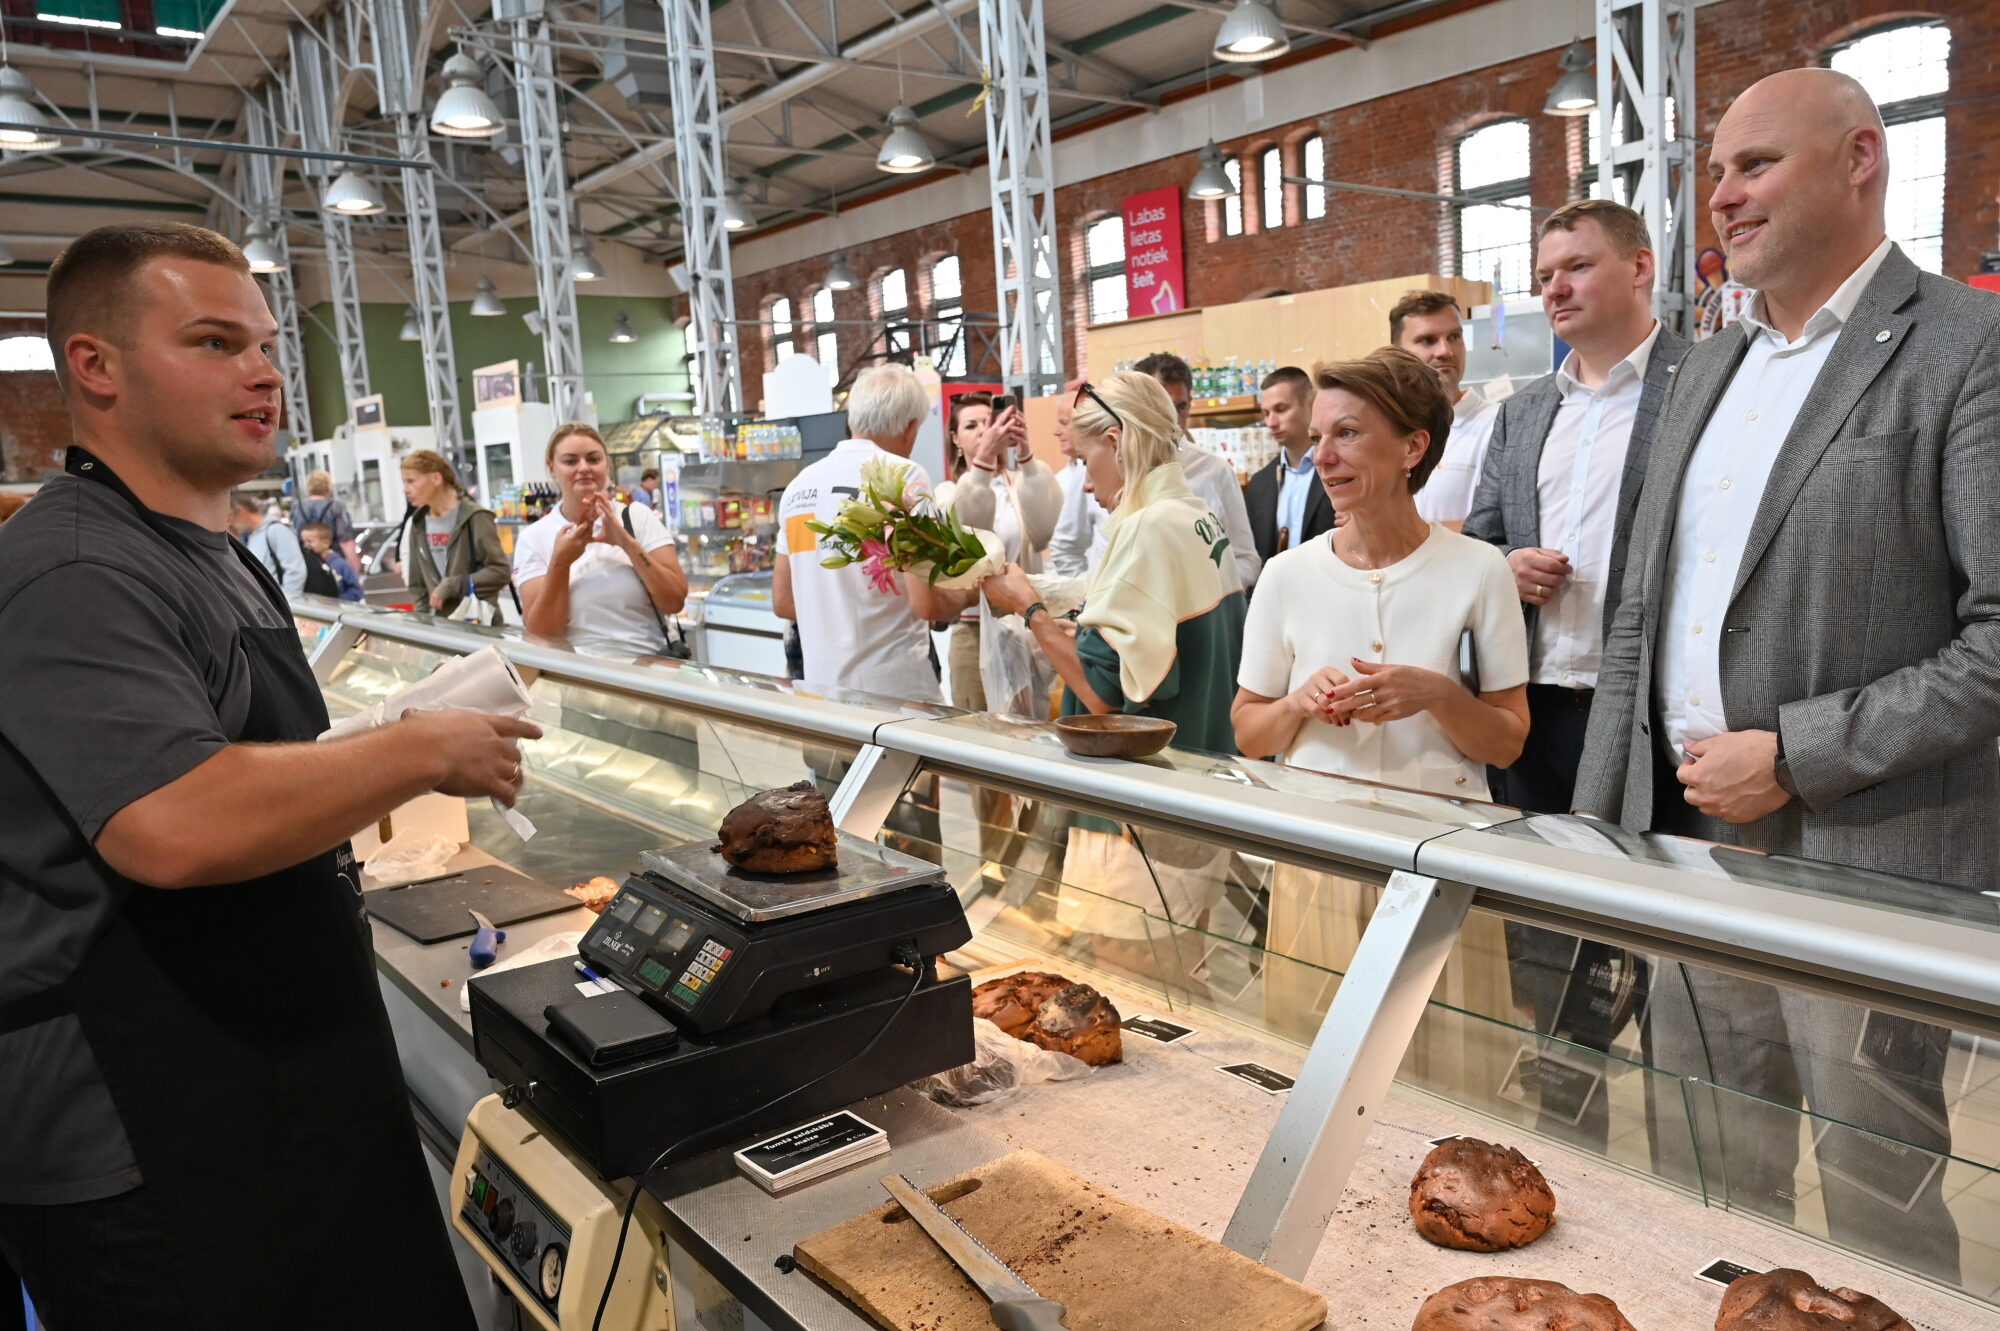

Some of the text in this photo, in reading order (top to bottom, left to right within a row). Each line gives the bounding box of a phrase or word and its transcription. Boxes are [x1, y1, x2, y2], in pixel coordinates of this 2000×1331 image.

[1128, 207, 1167, 227] Labas
[1130, 229, 1163, 247] lietas
[1131, 246, 1168, 268] notiek
[1132, 270, 1155, 289] šeit
[763, 1136, 793, 1151] Tumšā
[794, 1134, 819, 1147] maize
